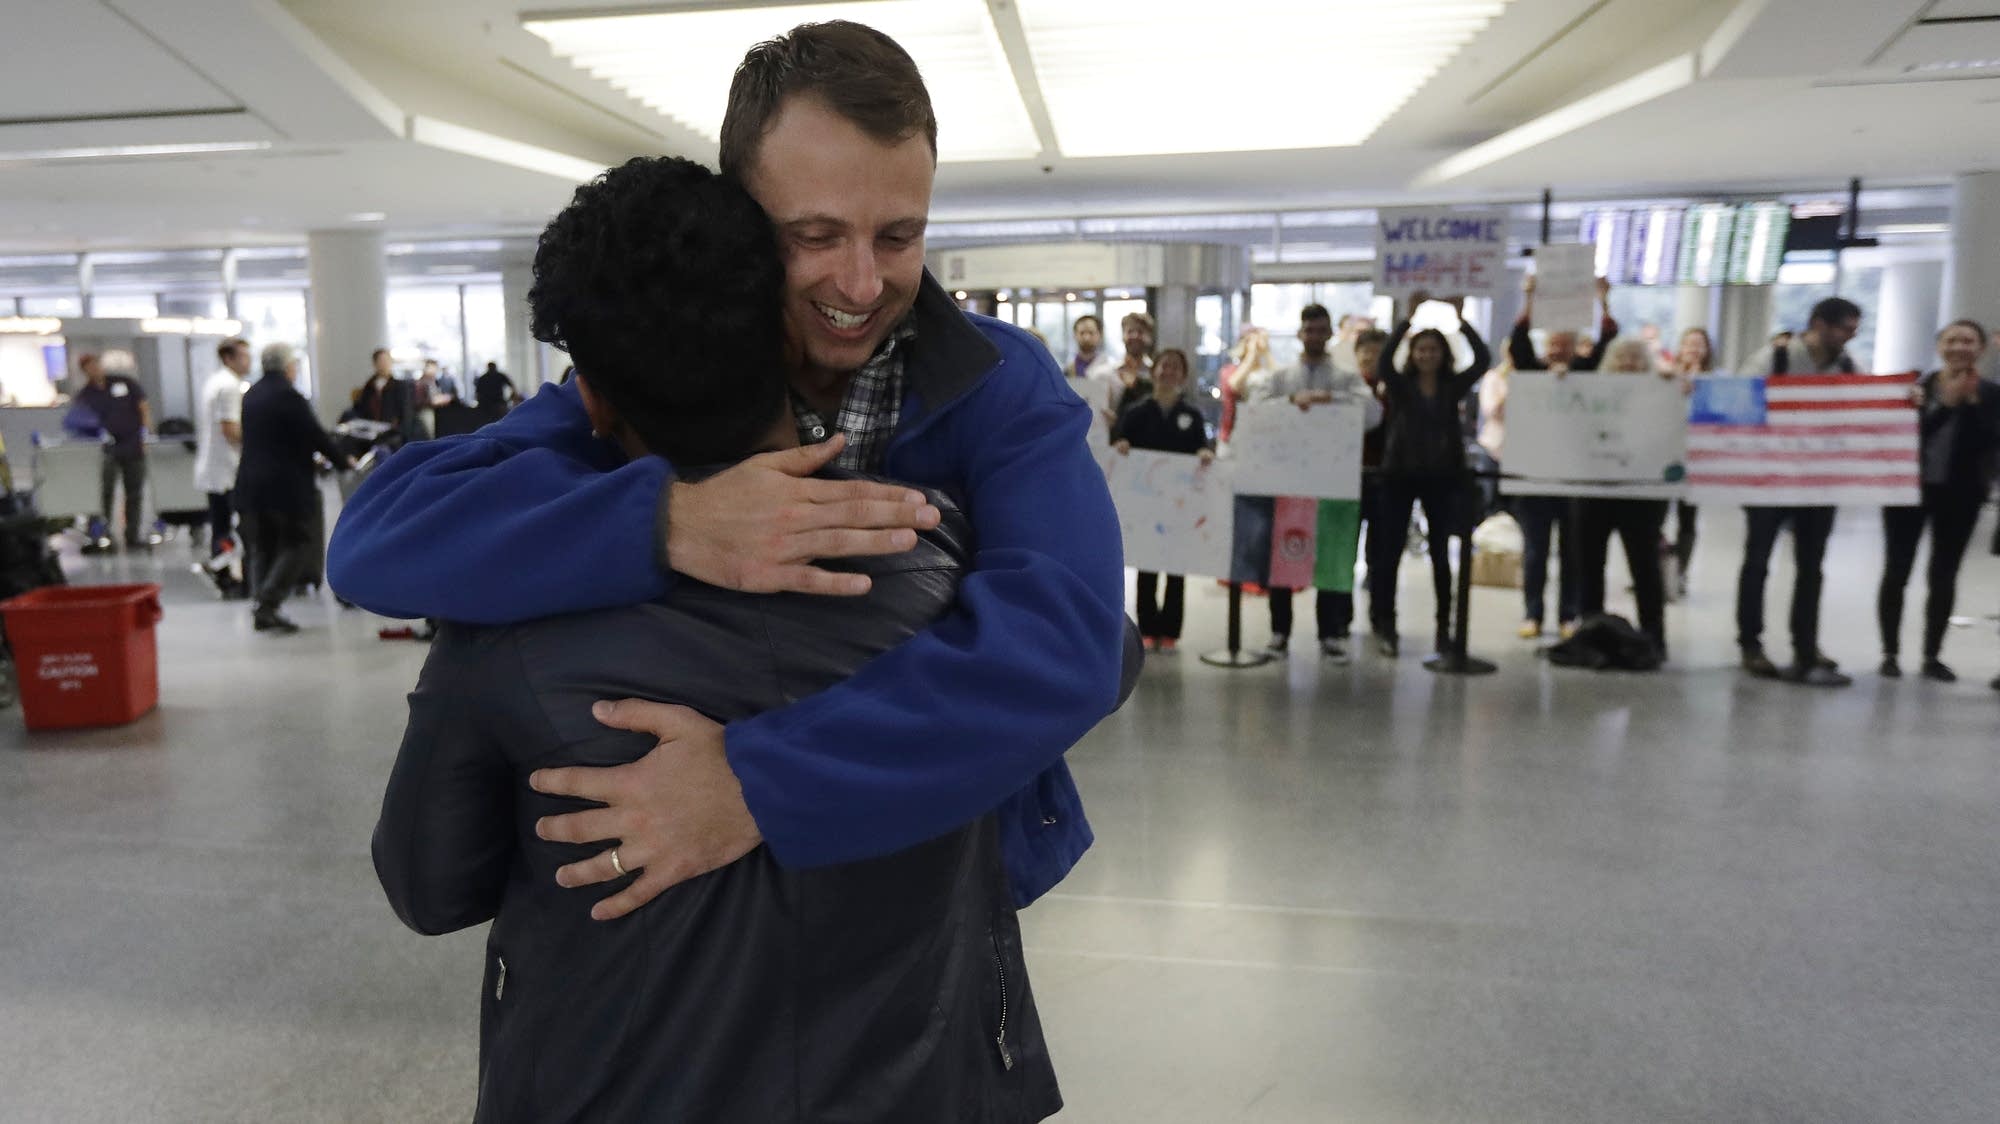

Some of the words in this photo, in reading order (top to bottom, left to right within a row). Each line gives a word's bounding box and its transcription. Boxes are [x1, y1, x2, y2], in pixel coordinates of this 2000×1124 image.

[1381, 218, 1500, 241] WELCOME
[1384, 252, 1495, 287] HOME
[39, 665, 98, 679] CAUTION
